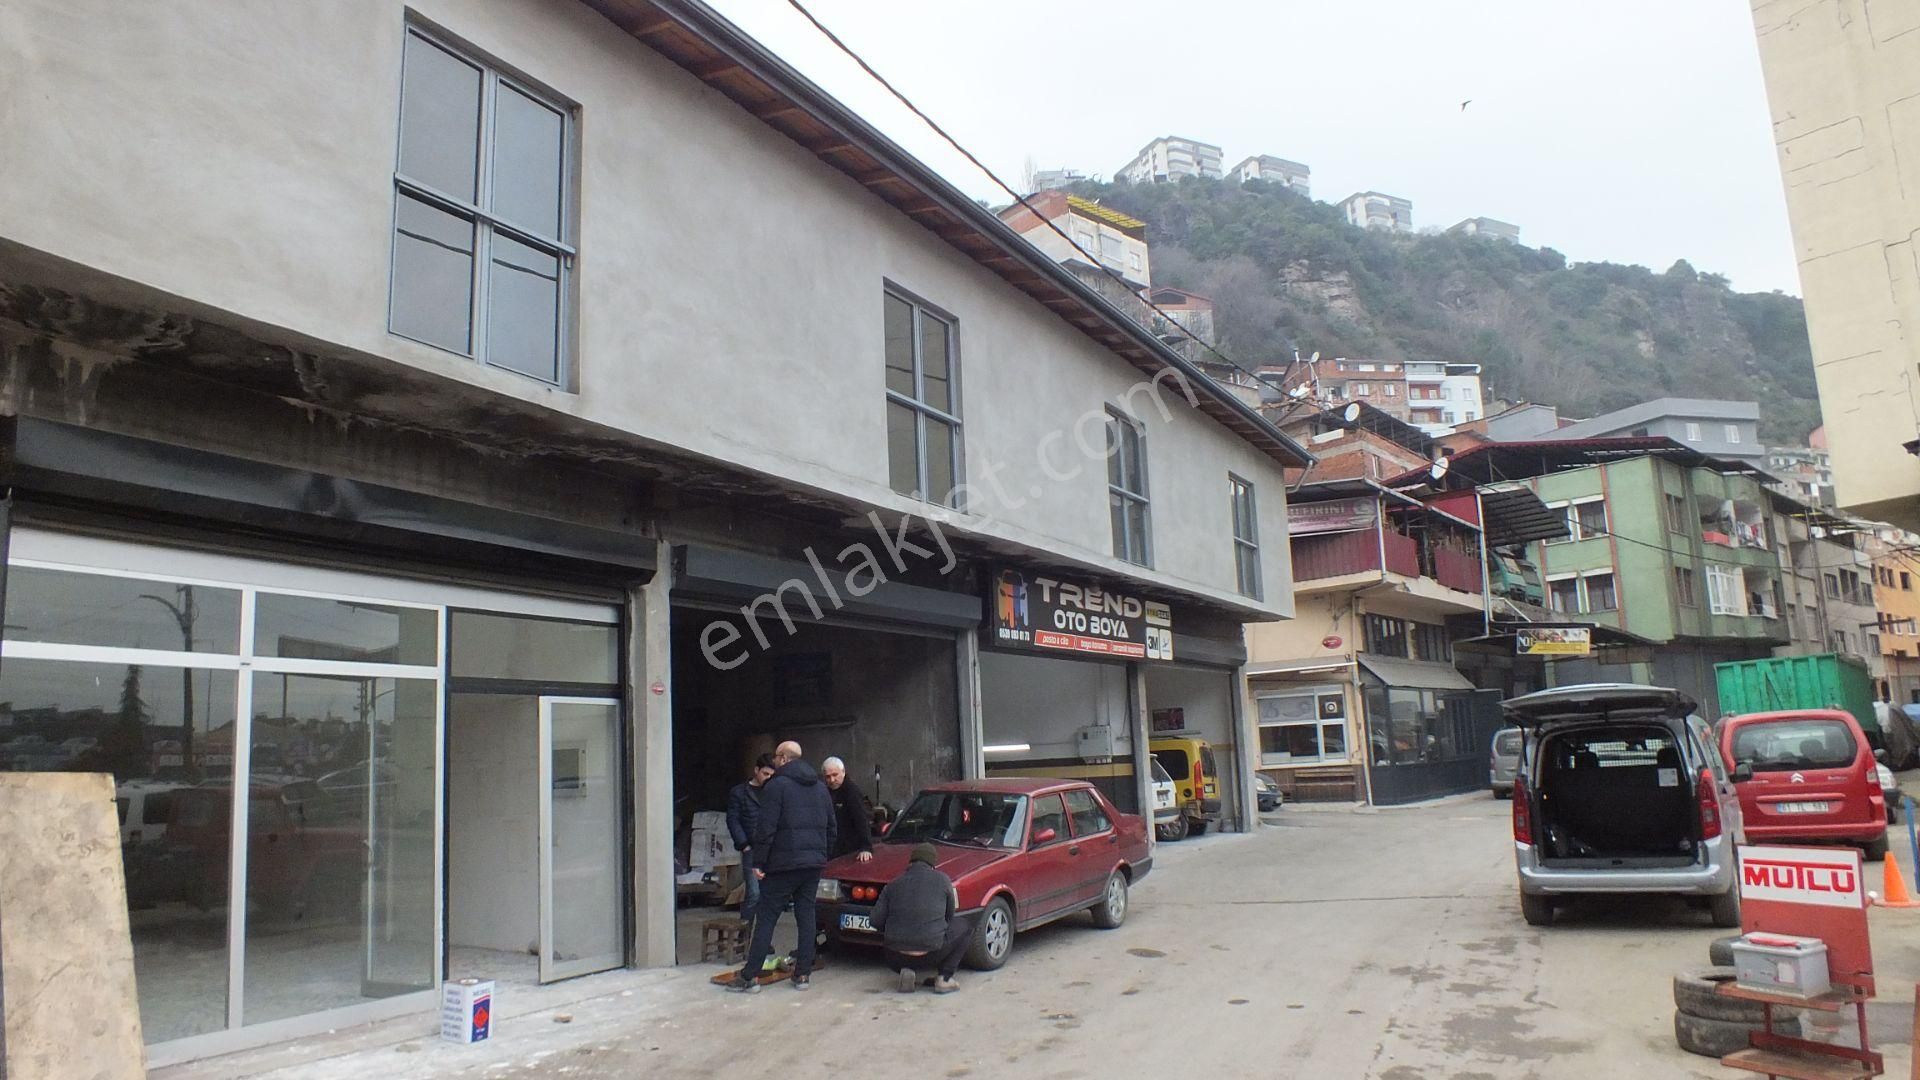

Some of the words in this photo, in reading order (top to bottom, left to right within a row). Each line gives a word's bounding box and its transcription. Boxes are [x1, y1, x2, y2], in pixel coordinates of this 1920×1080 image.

[1035, 577, 1143, 618] TREND
[1054, 609, 1087, 632] OTO
[1090, 617, 1129, 638] BOYA
[1148, 636, 1159, 650] 3M
[1743, 858, 1855, 893] MUTLU
[845, 916, 854, 928] 61
